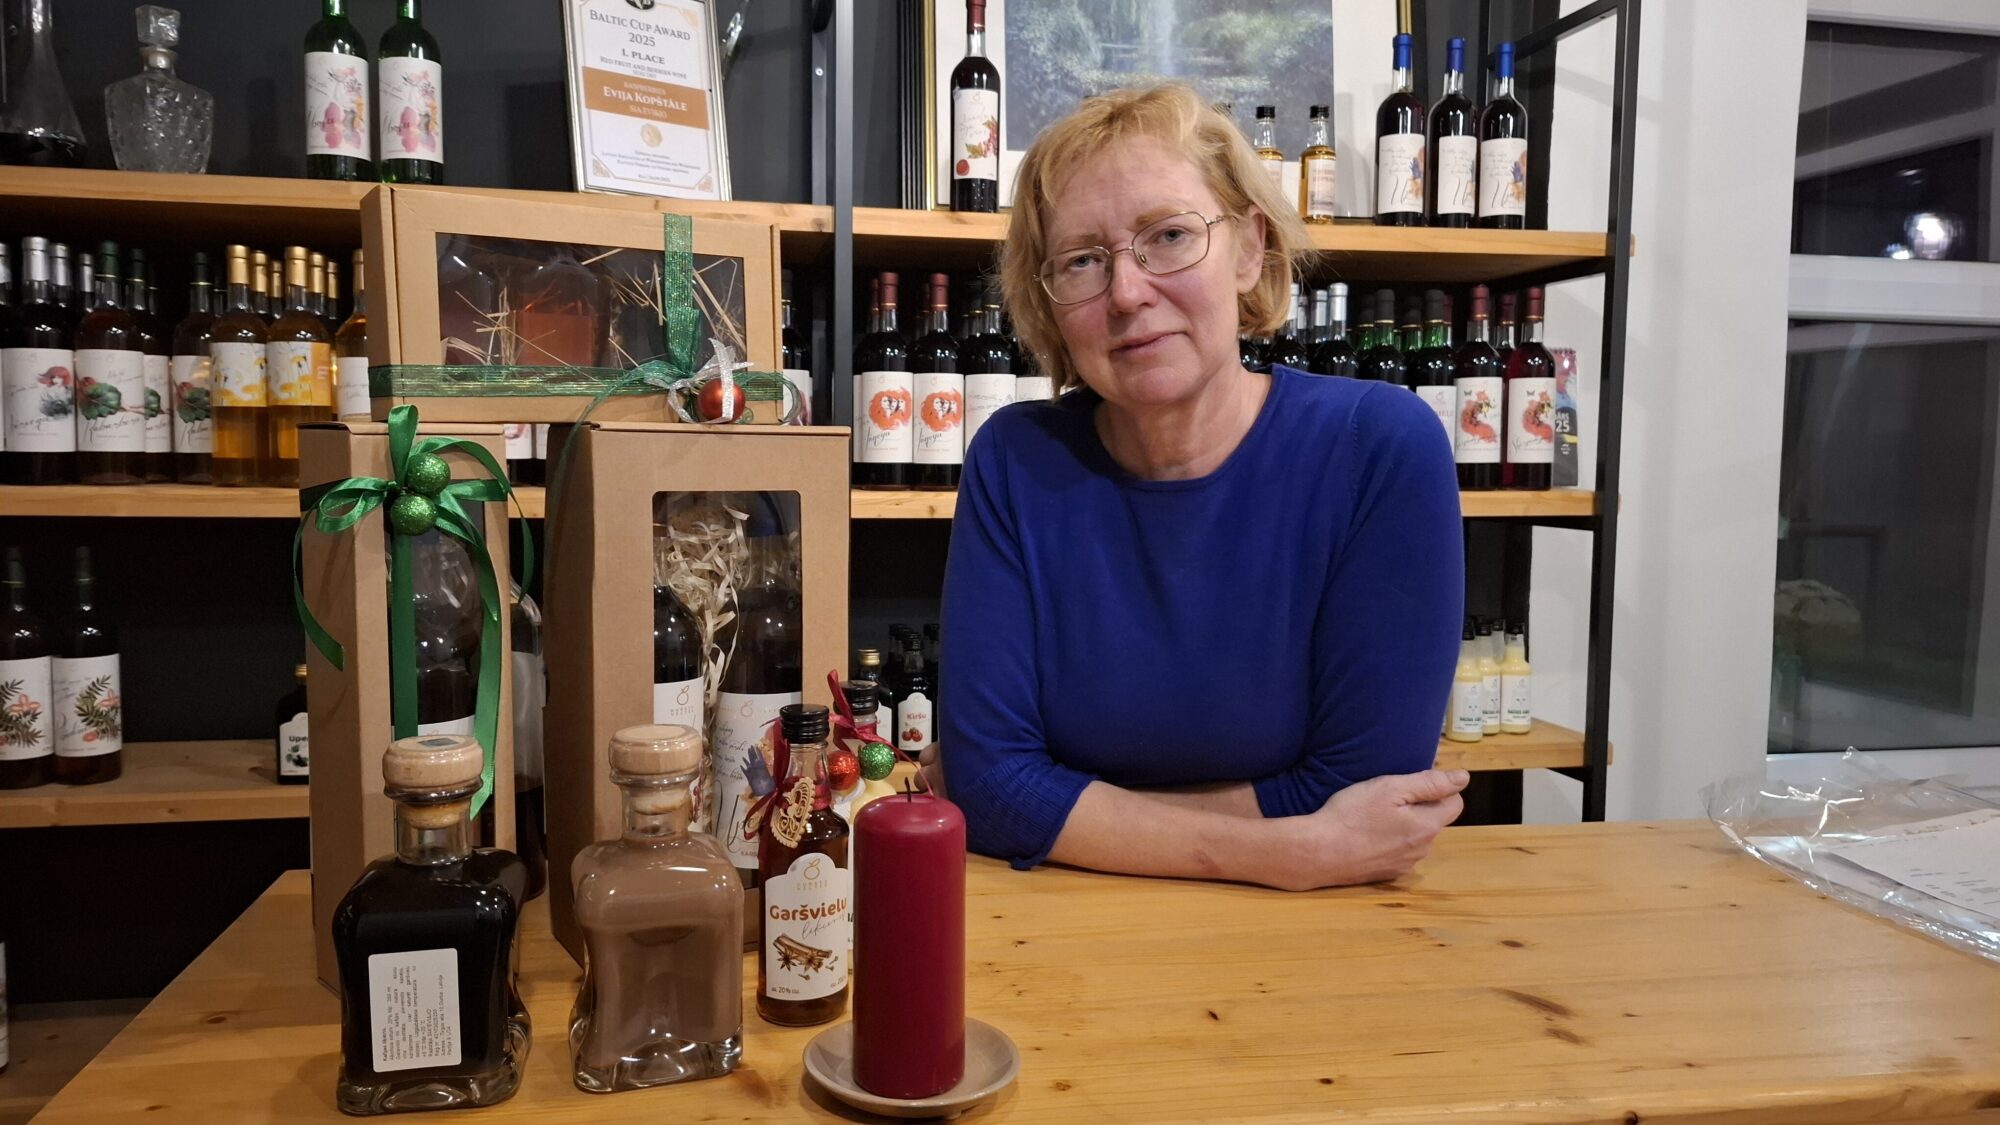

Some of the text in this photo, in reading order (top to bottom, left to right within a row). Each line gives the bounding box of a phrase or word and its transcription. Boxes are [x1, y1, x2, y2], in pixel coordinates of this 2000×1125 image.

[630, 18, 652, 32] CUP
[653, 24, 691, 41] AWARD
[628, 32, 656, 47] 2025
[631, 50, 666, 64] PLACE
[289, 735, 308, 743] Upe
[769, 897, 847, 921] Garšvielu
